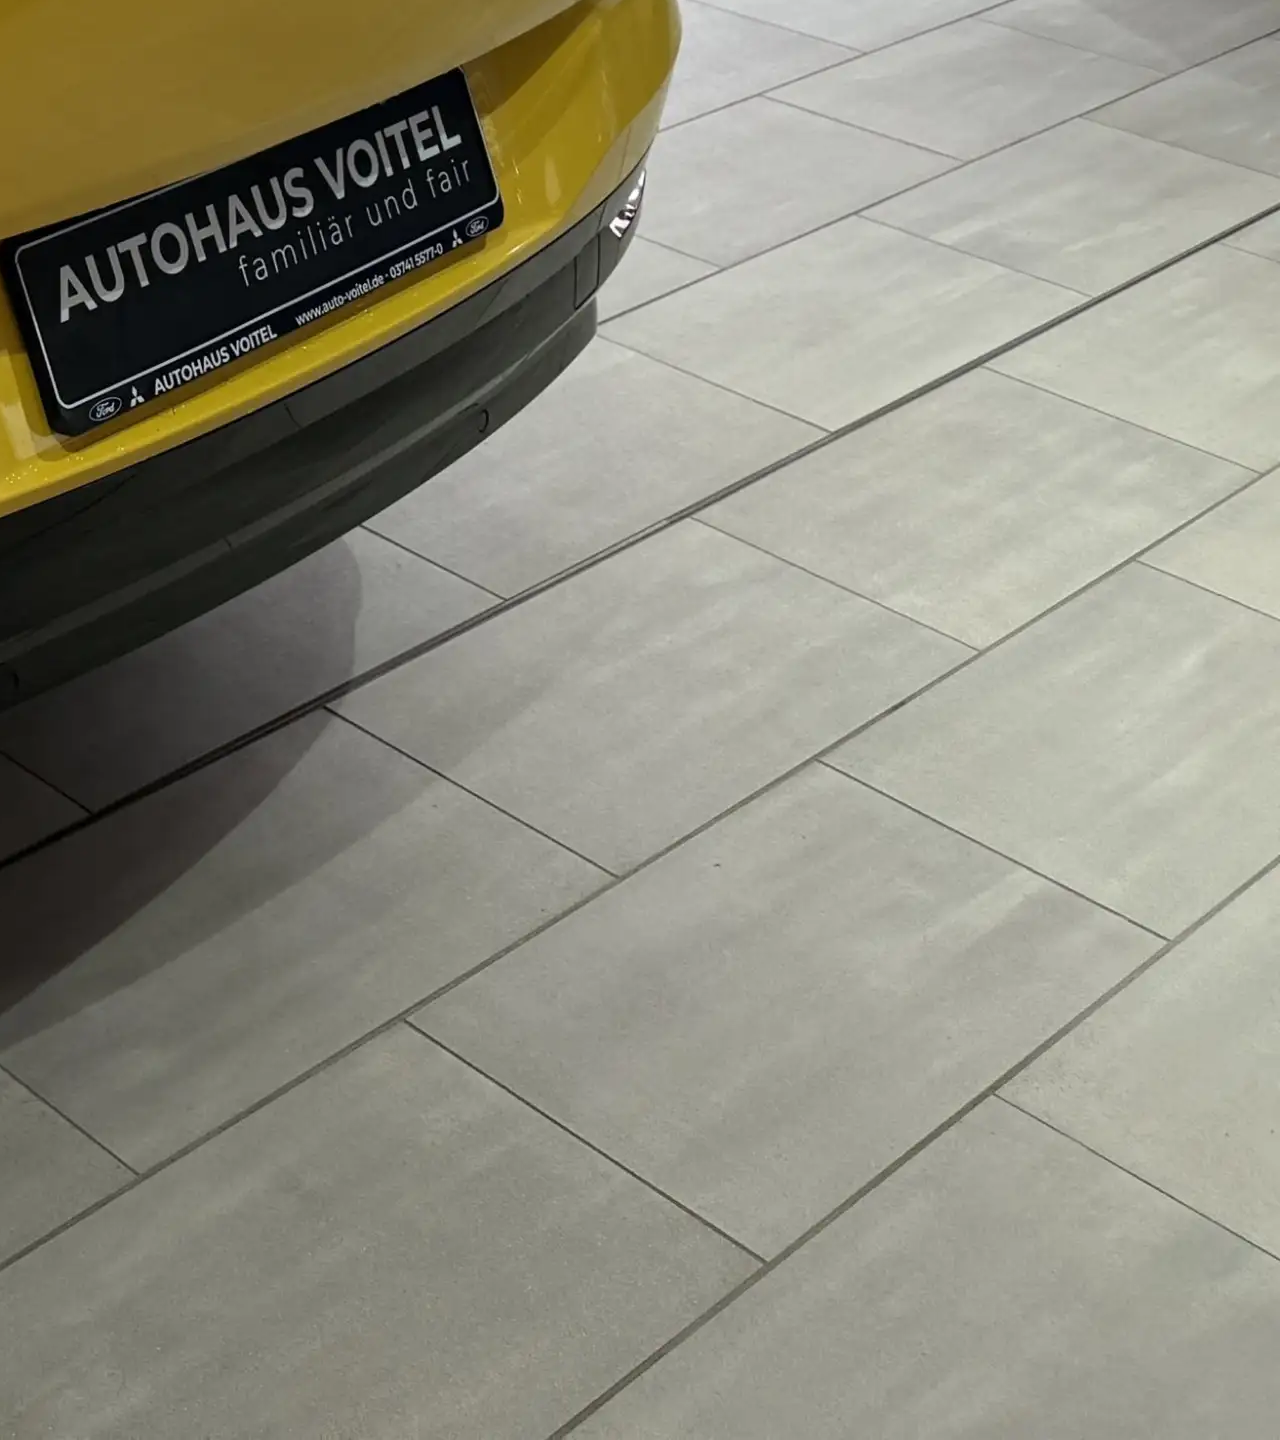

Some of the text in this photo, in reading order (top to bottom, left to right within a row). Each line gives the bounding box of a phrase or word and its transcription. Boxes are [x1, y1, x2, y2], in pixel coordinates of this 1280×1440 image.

[60, 105, 462, 324] AUTOHAUS VOITEL
[238, 158, 471, 288] familiär und fair
[154, 346, 230, 395] AUTOHAUS
[230, 324, 278, 357] VOITEL
[294, 274, 385, 327] www.auto-voitel.de
[389, 257, 414, 279] 03741
[415, 243, 444, 268] 5577-0
